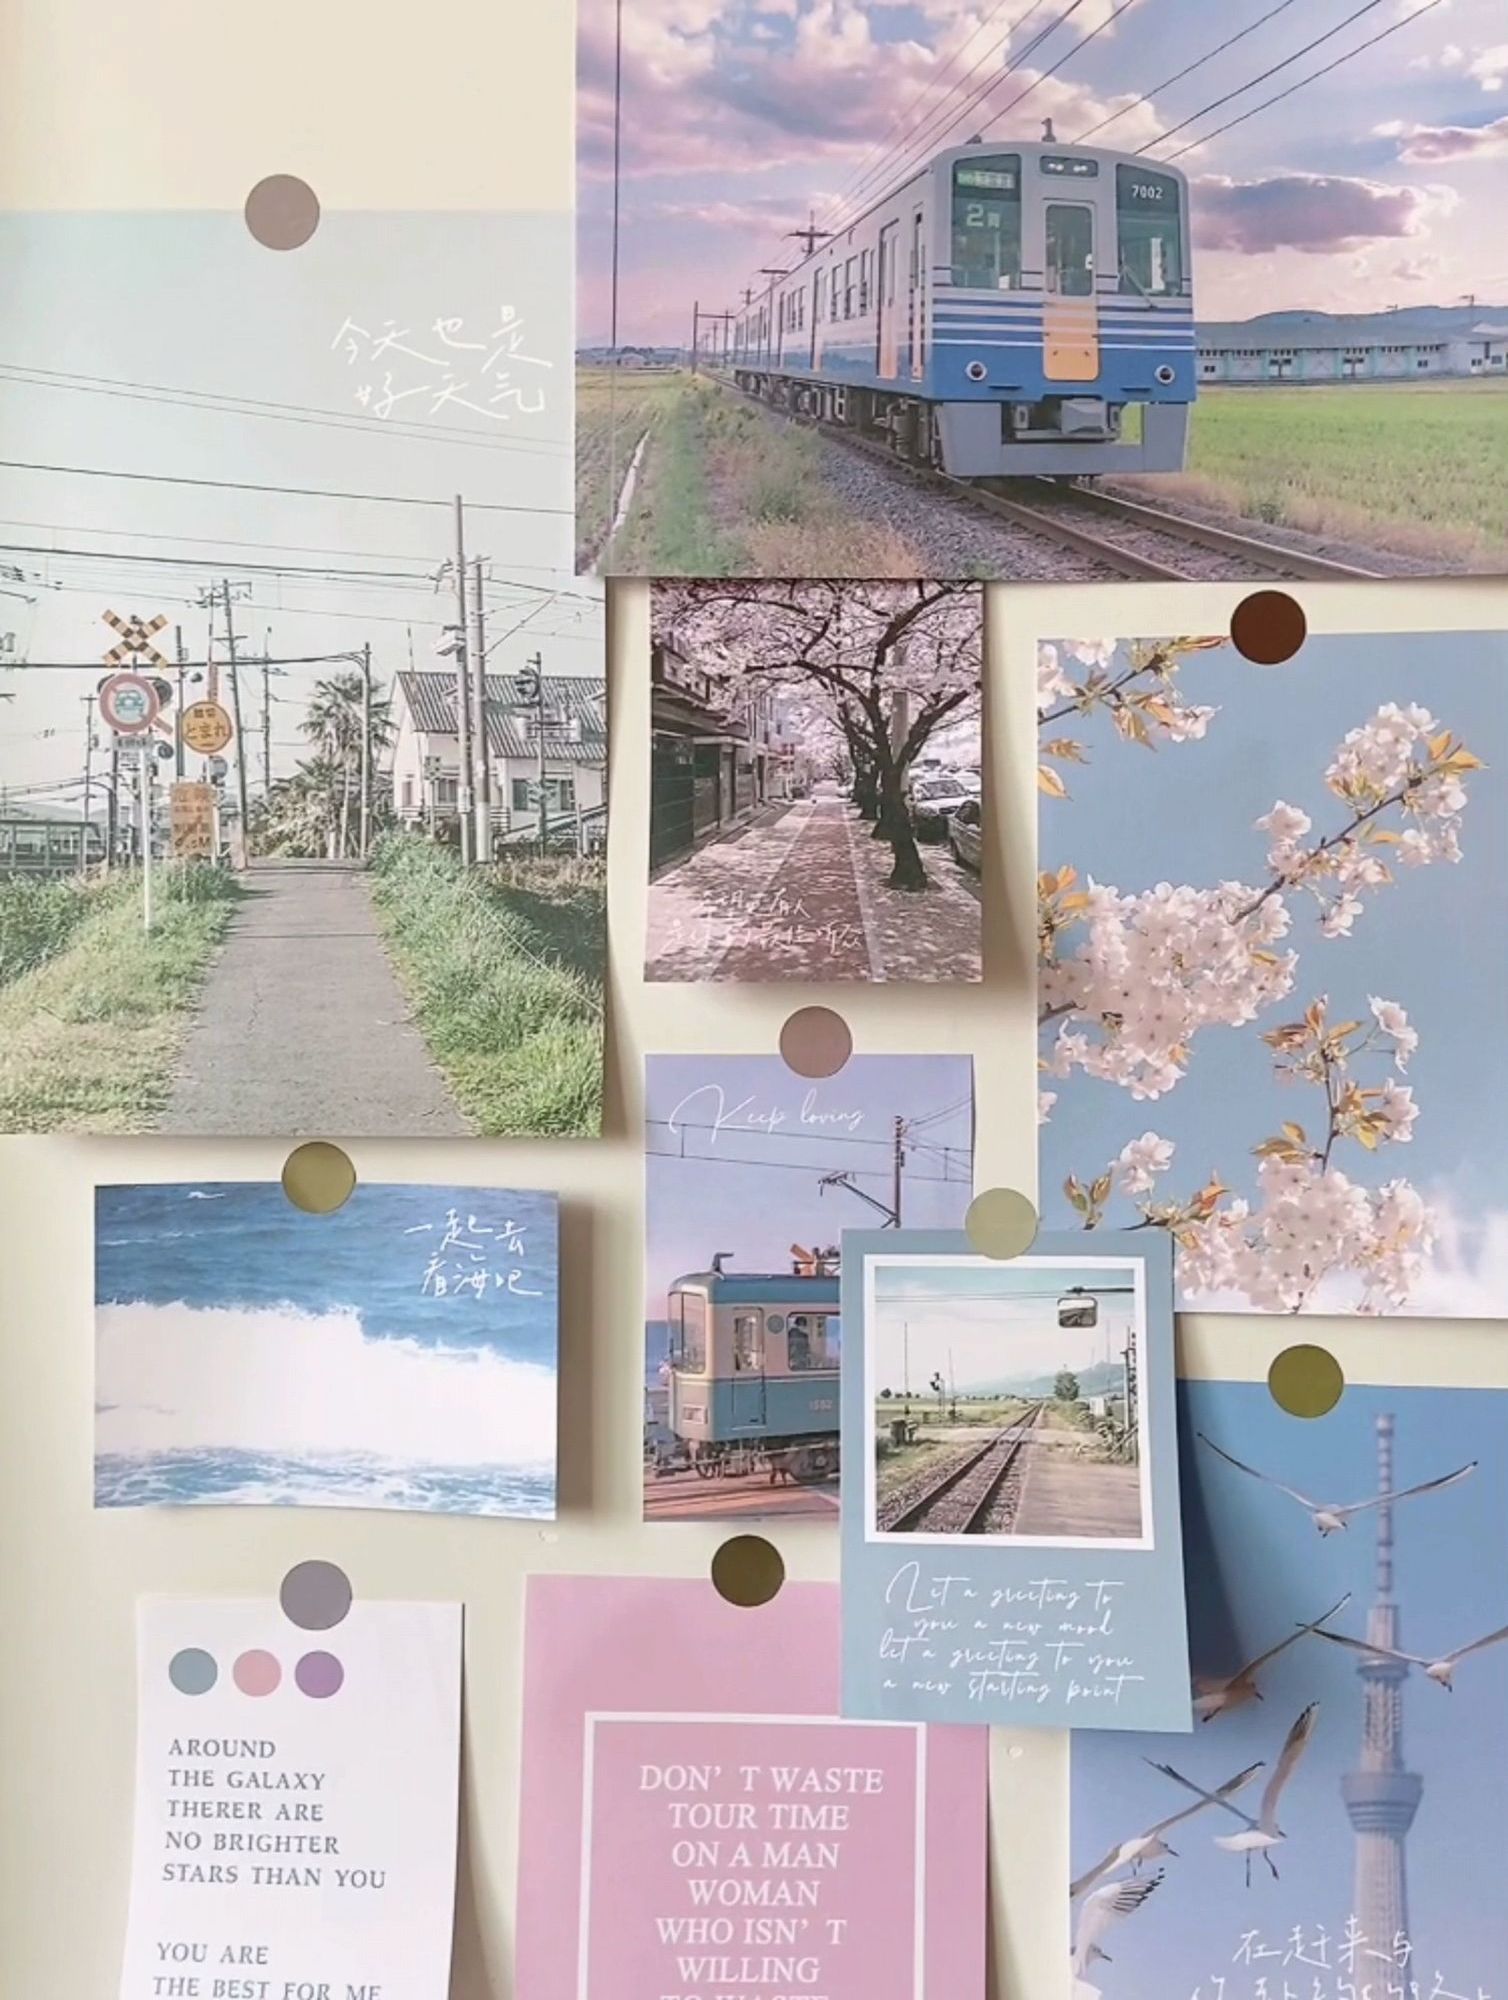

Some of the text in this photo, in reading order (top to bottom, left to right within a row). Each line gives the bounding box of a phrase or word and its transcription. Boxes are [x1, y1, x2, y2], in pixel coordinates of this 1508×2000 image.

[1131, 185, 1163, 199] 7002
[330, 304, 553, 373] 今天也是
[354, 371, 546, 420] 好天气
[668, 1083, 866, 1144] Keep loving
[403, 1207, 527, 1257] 一起去
[421, 1251, 544, 1300] 看海吧
[885, 1560, 1125, 1613] Let a greeting to
[913, 1609, 1114, 1638] you a new mood
[921, 1648, 937, 1659] a
[951, 1640, 1040, 1669] greeting
[1044, 1642, 1086, 1672] to
[1088, 1653, 1134, 1673] you
[882, 1671, 1145, 1705] a new starting point
[168, 1738, 277, 1759] AROUND
[168, 1768, 326, 1791] THE GALAXY
[769, 1766, 885, 1795] WASTE
[167, 1799, 324, 1822] THERER ARE
[668, 1802, 851, 1831] TOUR TIME
[164, 1831, 340, 1855] NO BRIGHTER
[671, 1840, 841, 1869] ON A MAN
[161, 1862, 387, 1890] STARS THAN YOU
[687, 1878, 822, 1907] WOMAN
[655, 1917, 735, 1945] WHO
[1231, 1913, 1413, 1974] 在赶来与
[156, 1942, 269, 1966] YOU ARE
[675, 1956, 822, 1984] WILLING
[153, 1976, 382, 2000] THE BEST FOR ME
